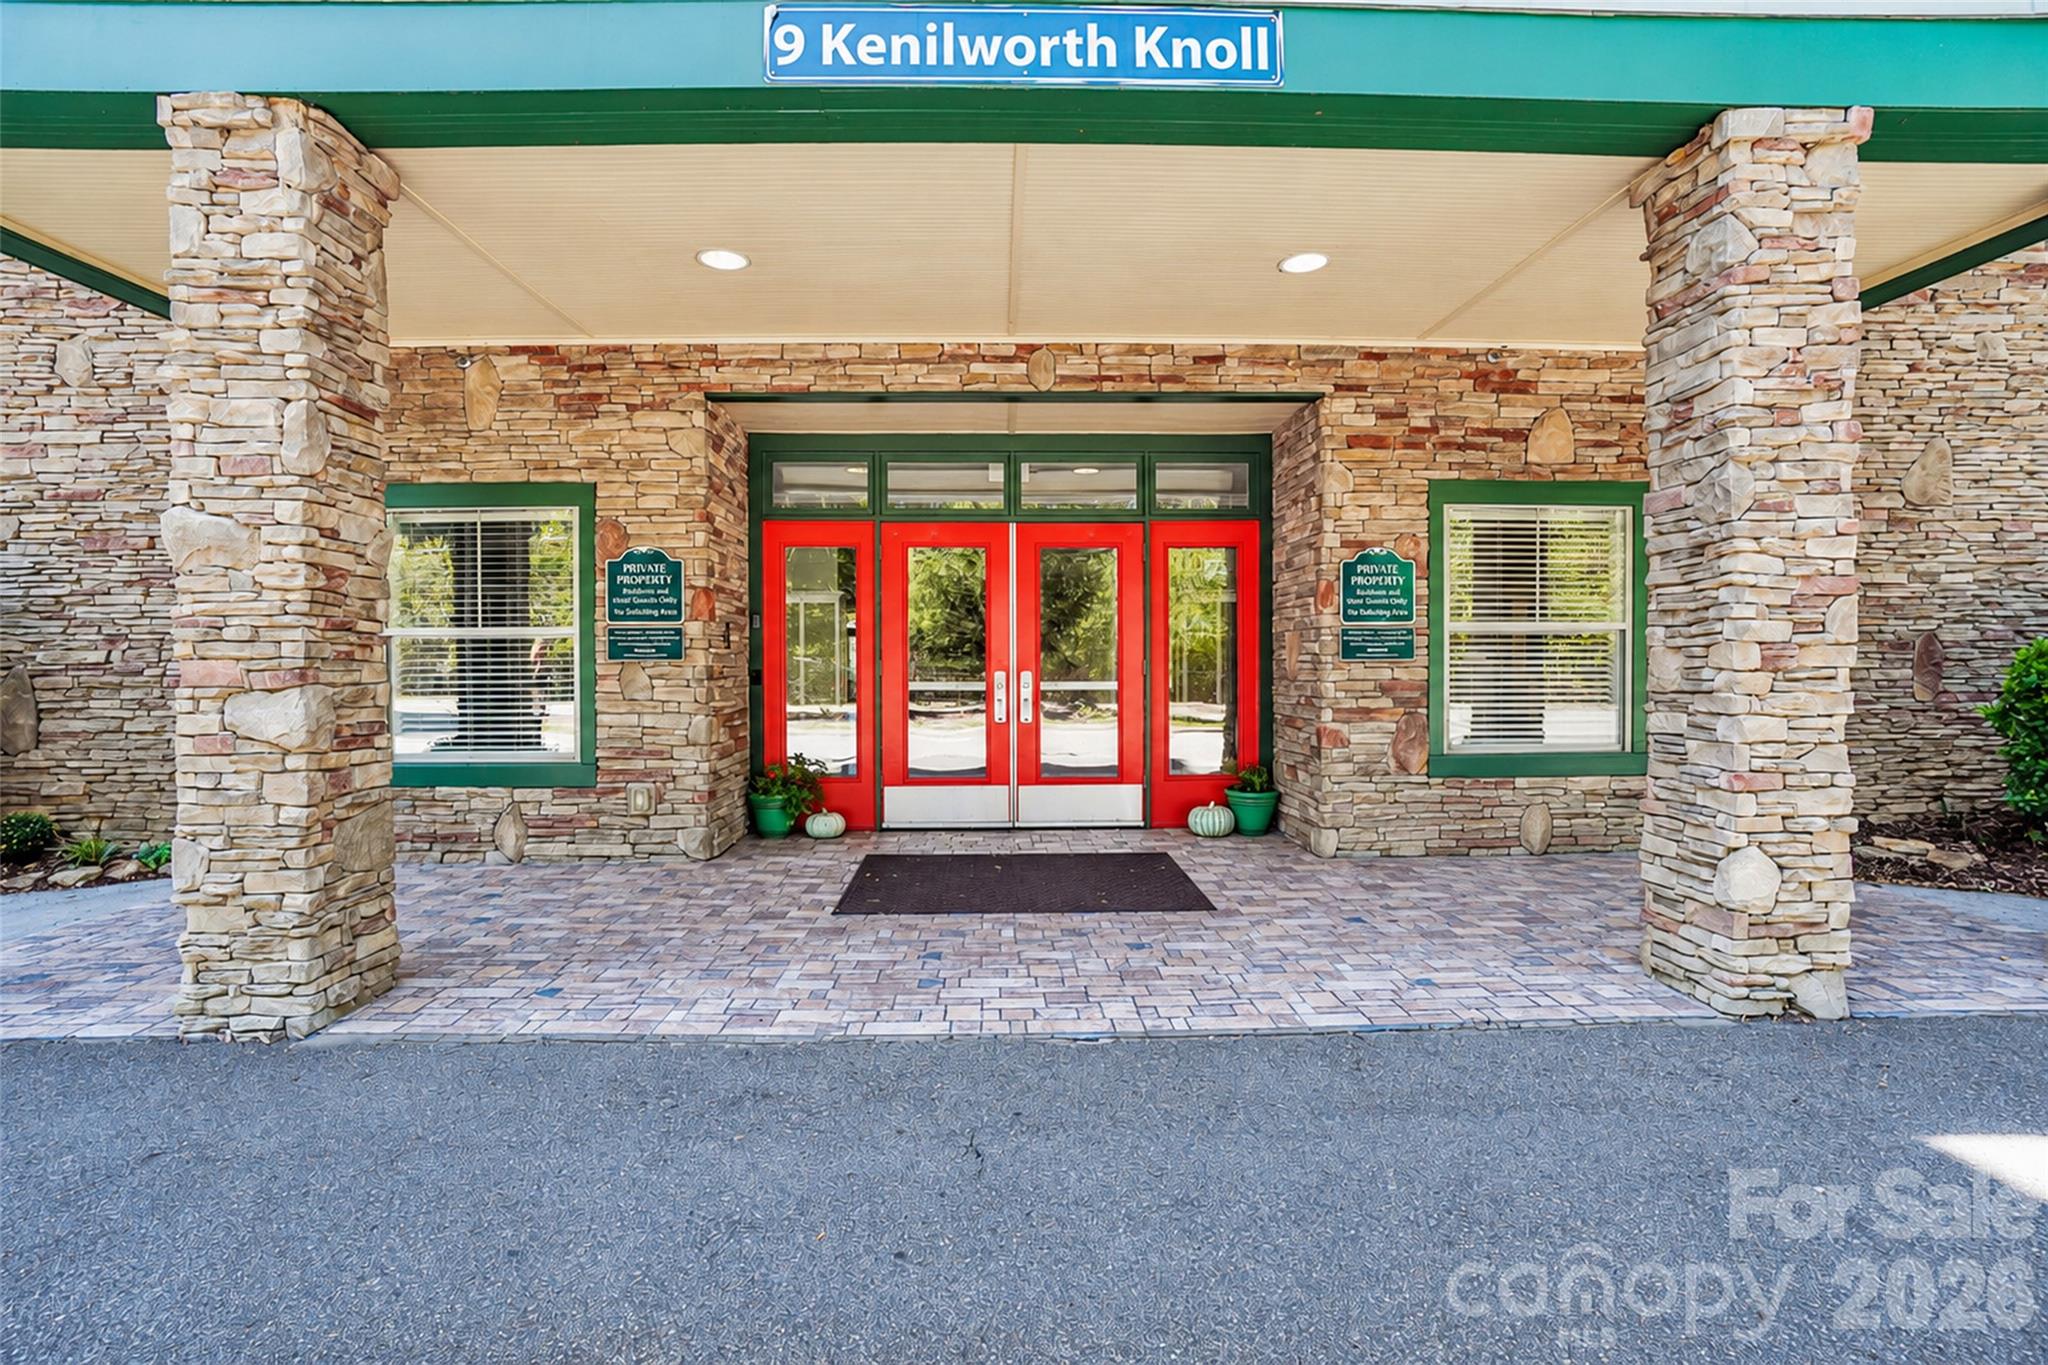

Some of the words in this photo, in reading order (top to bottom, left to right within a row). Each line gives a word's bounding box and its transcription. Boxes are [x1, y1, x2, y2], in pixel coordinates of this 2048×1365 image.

[773, 24, 806, 67] 9
[821, 22, 1117, 69] Kenilworth
[1135, 26, 1269, 71] Knoll
[623, 563, 667, 573] PRIVATE
[1356, 564, 1399, 574] PRIVATE
